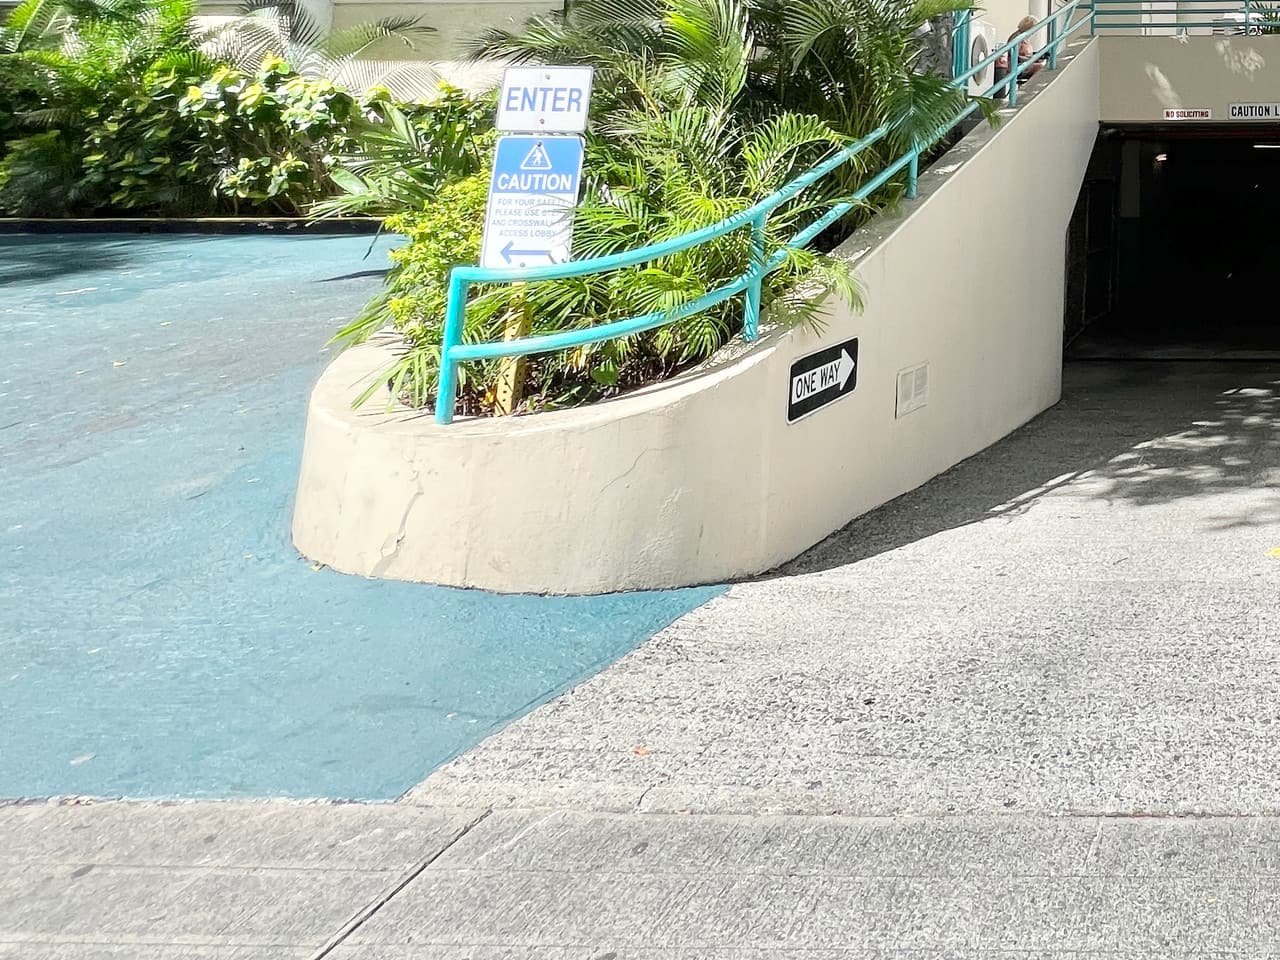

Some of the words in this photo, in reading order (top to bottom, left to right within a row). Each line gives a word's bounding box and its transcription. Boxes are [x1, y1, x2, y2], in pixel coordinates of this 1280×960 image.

[505, 86, 583, 113] ENTER
[1165, 110, 1175, 118] NO
[1176, 110, 1209, 118] SOLICITING
[1231, 105, 1271, 117] CAUTION
[497, 172, 573, 191] CAUTION
[497, 198, 513, 206] FOR
[514, 198, 535, 206] YOUR
[495, 208, 523, 216] PLEASE
[524, 208, 541, 217] USE
[491, 218, 506, 226] AND
[499, 228, 529, 238] ACCESS
[795, 371, 817, 398] ONE
[820, 361, 841, 388] WAY
